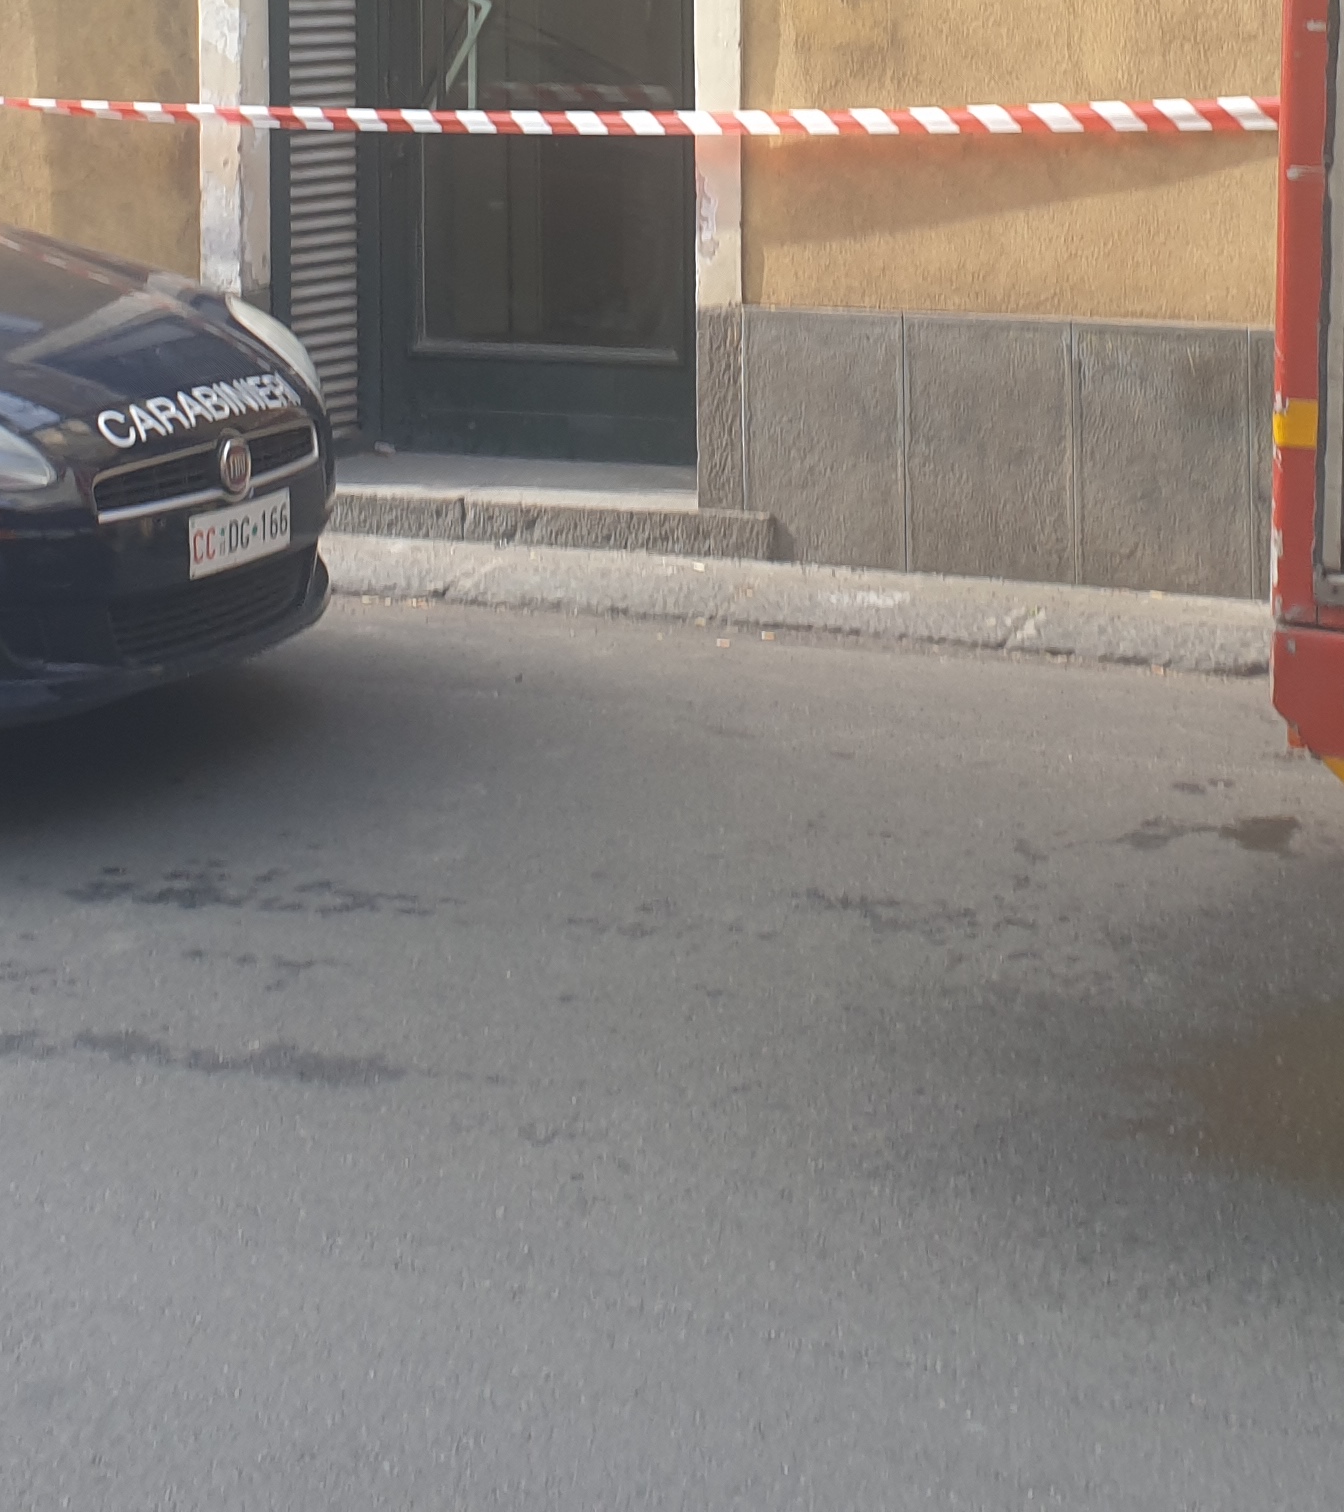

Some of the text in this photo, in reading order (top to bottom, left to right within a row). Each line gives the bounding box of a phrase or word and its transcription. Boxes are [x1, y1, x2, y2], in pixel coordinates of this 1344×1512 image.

[97, 372, 302, 449] CARABINIERI
[192, 525, 216, 565] CC
[261, 501, 288, 544] 166
